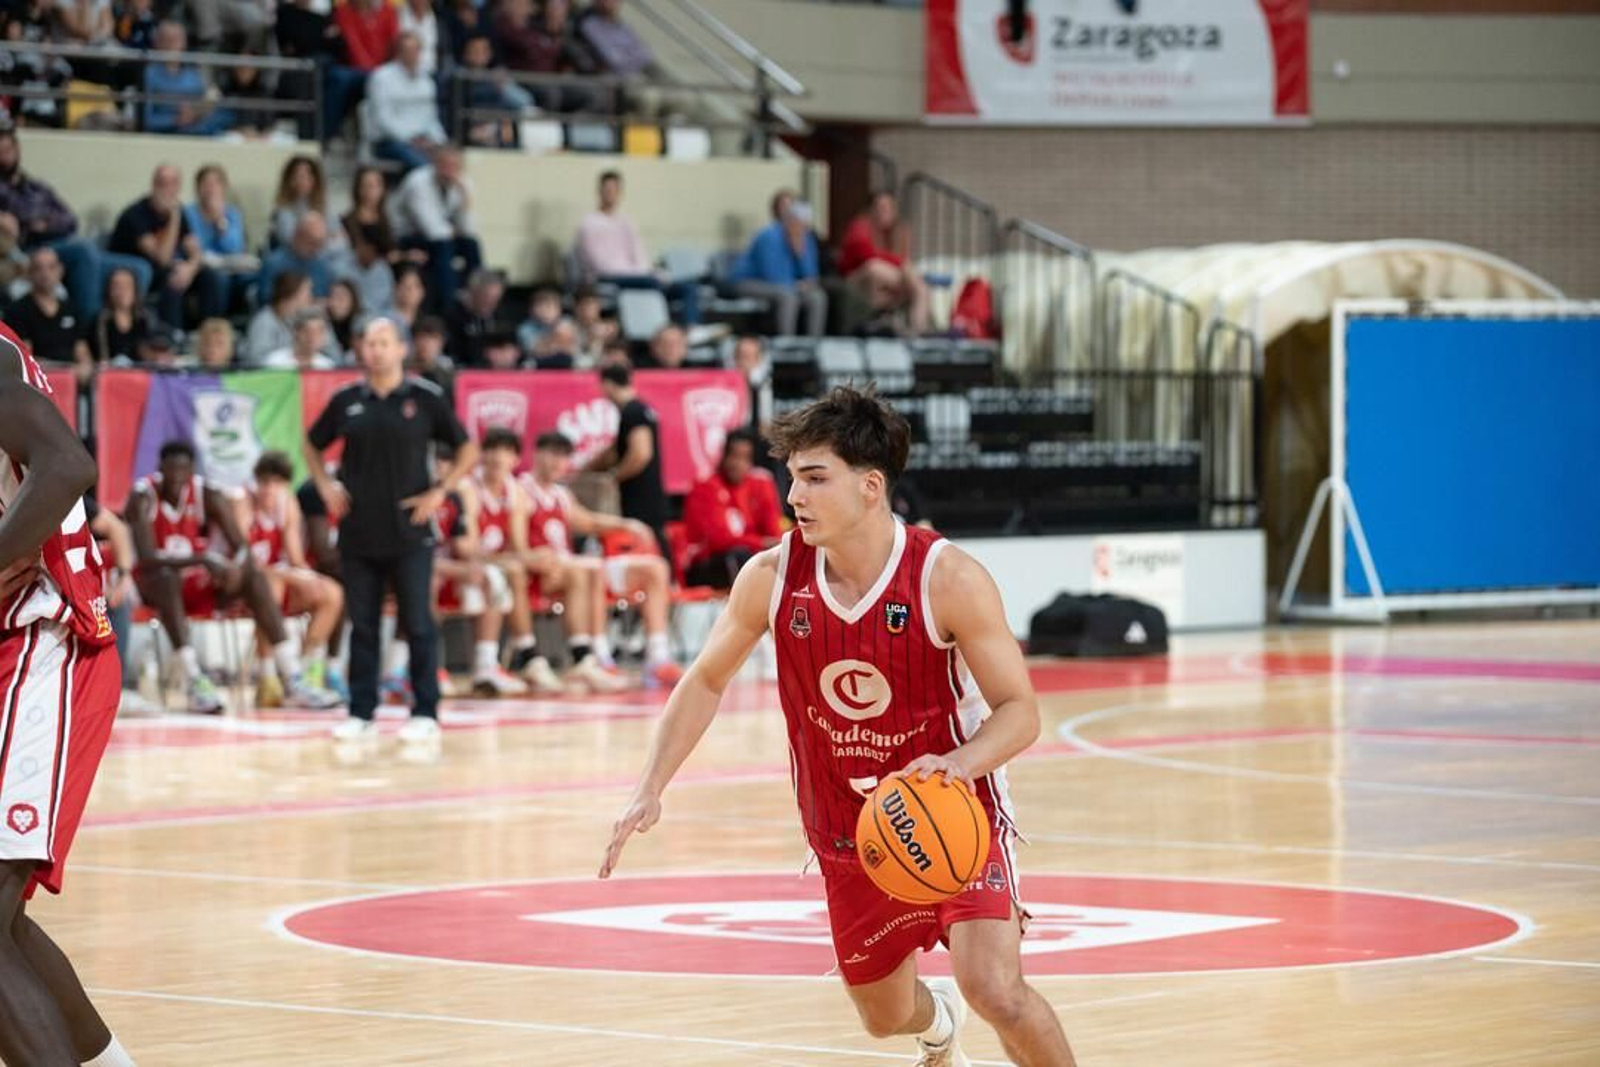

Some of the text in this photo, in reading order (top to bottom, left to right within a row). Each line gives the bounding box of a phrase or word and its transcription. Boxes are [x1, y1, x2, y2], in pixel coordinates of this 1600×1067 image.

[1050, 16, 1222, 60] Zaragoza
[885, 603, 908, 614] LIGA
[881, 788, 933, 873] Wilson
